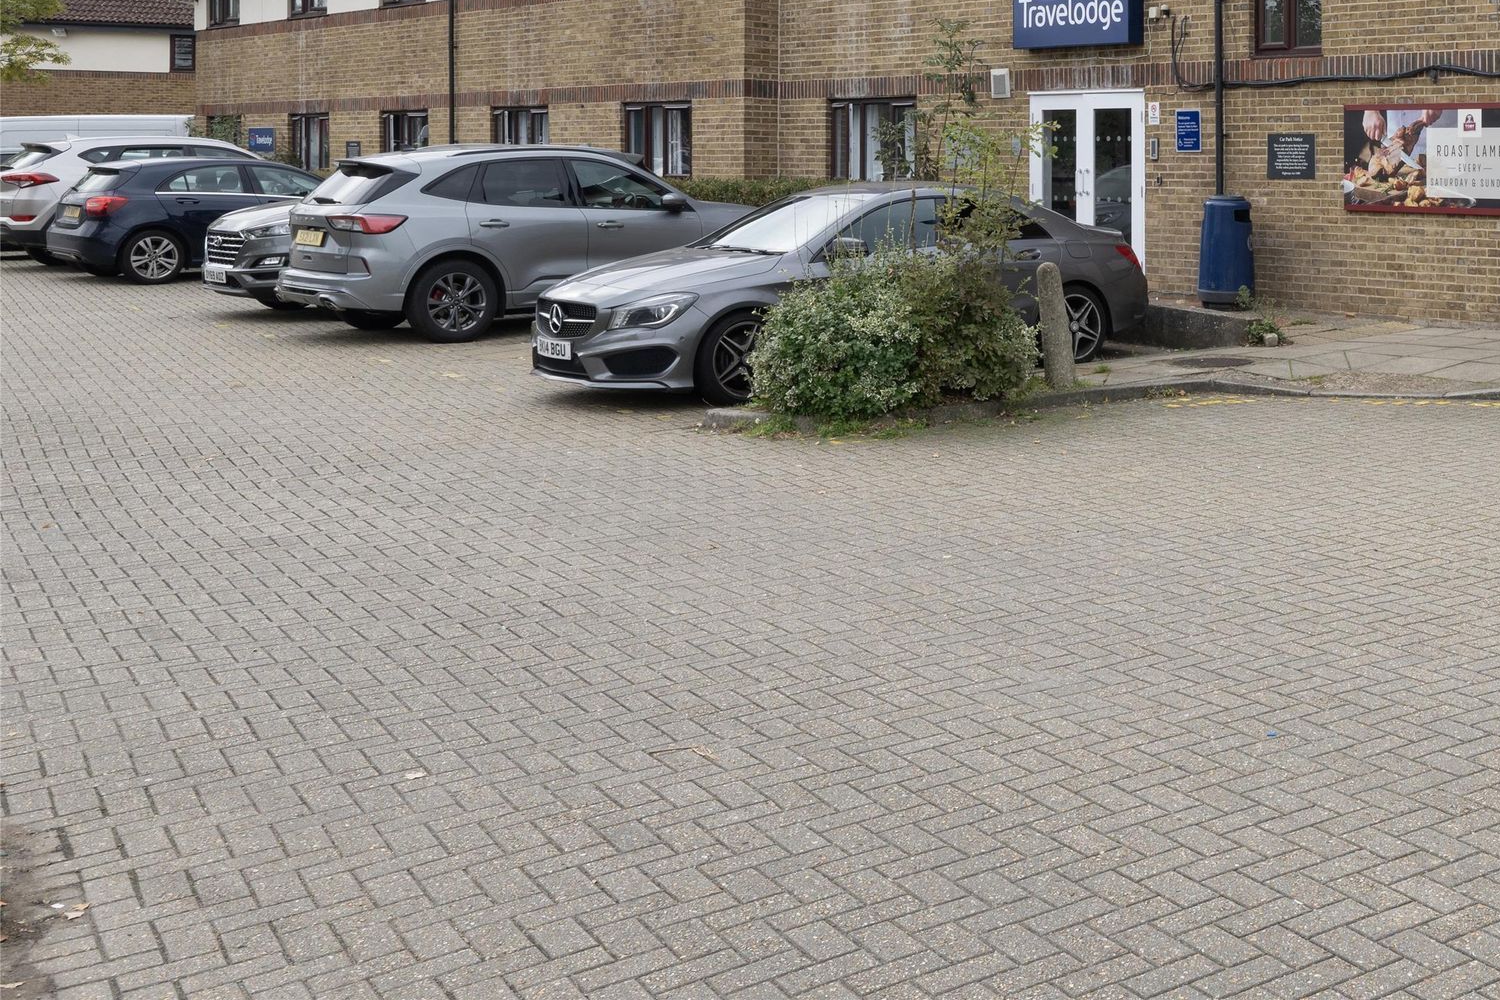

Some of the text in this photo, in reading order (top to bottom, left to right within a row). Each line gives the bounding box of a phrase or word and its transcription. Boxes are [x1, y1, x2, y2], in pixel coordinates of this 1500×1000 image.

[1436, 144, 1470, 157] ROAST
[1458, 163, 1482, 172] EVERY
[1430, 177, 1468, 187] SATURDAY
[1471, 178, 1476, 187] &
[550, 342, 566, 357] BGU
